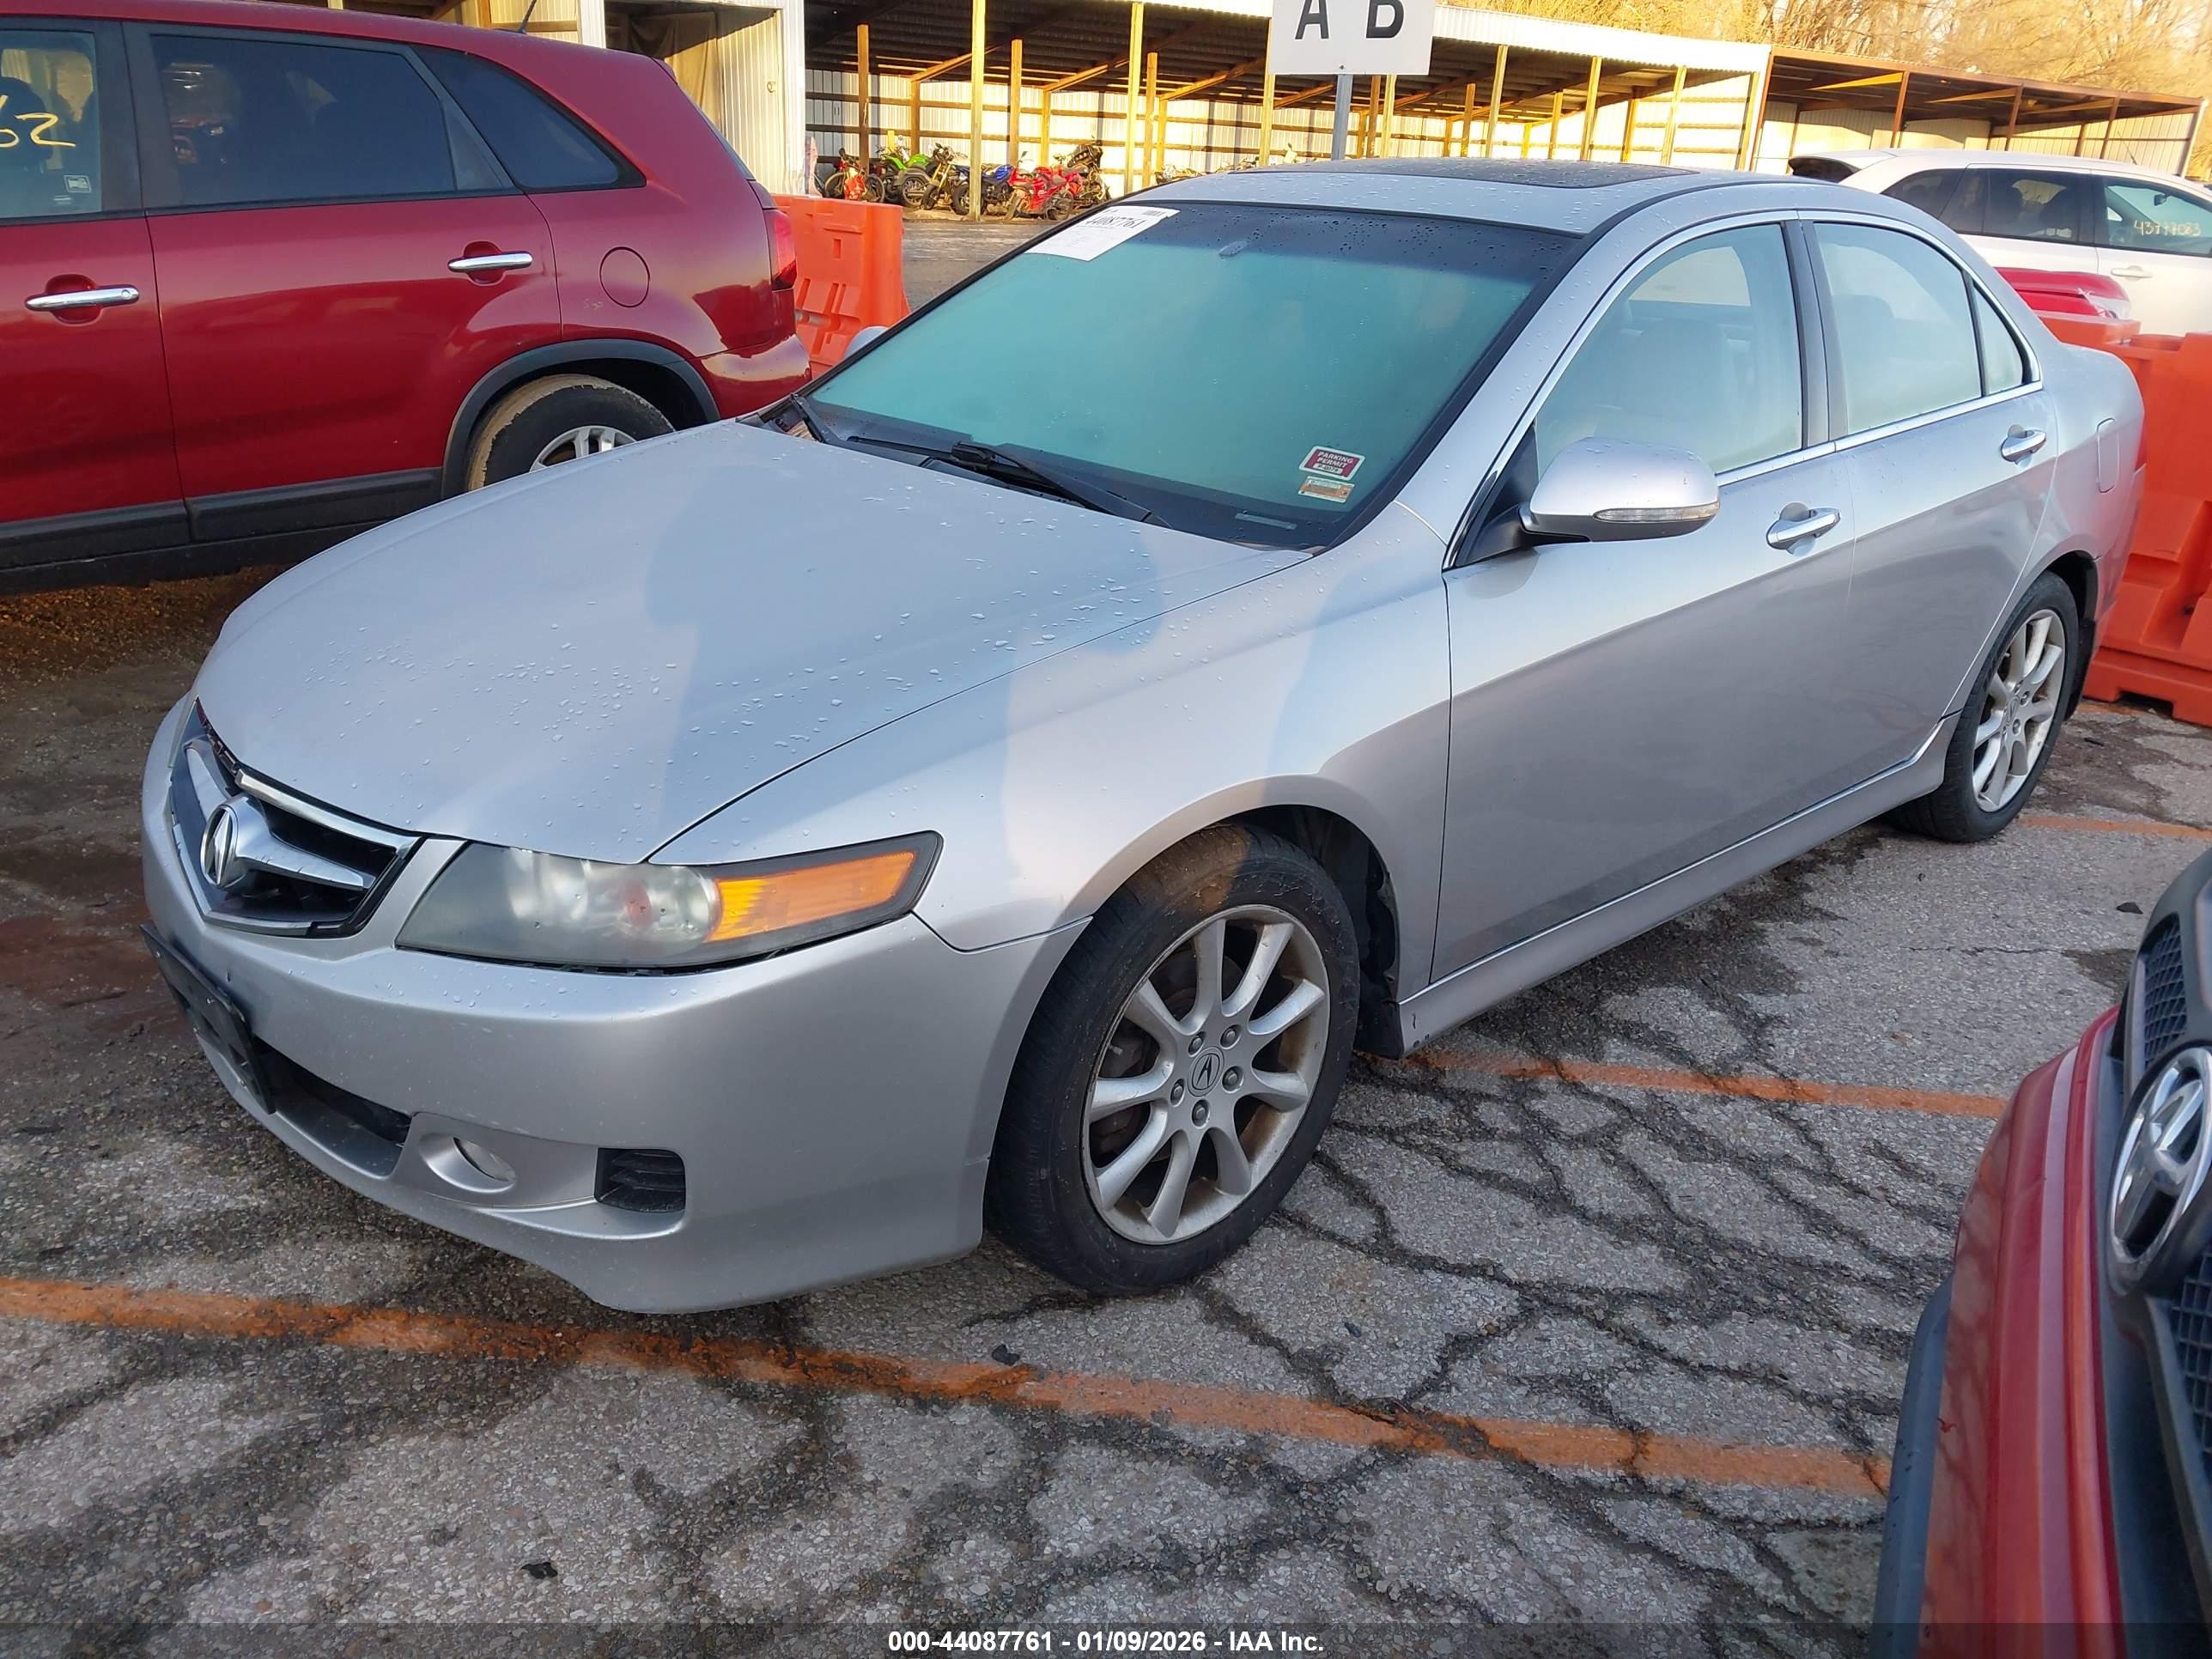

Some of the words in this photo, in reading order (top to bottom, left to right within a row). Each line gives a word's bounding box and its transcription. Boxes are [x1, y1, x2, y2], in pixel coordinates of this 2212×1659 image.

[1295, 0, 1329, 40] A
[1316, 457, 1347, 468] PERMIT
[1318, 452, 1353, 463] PARKING
